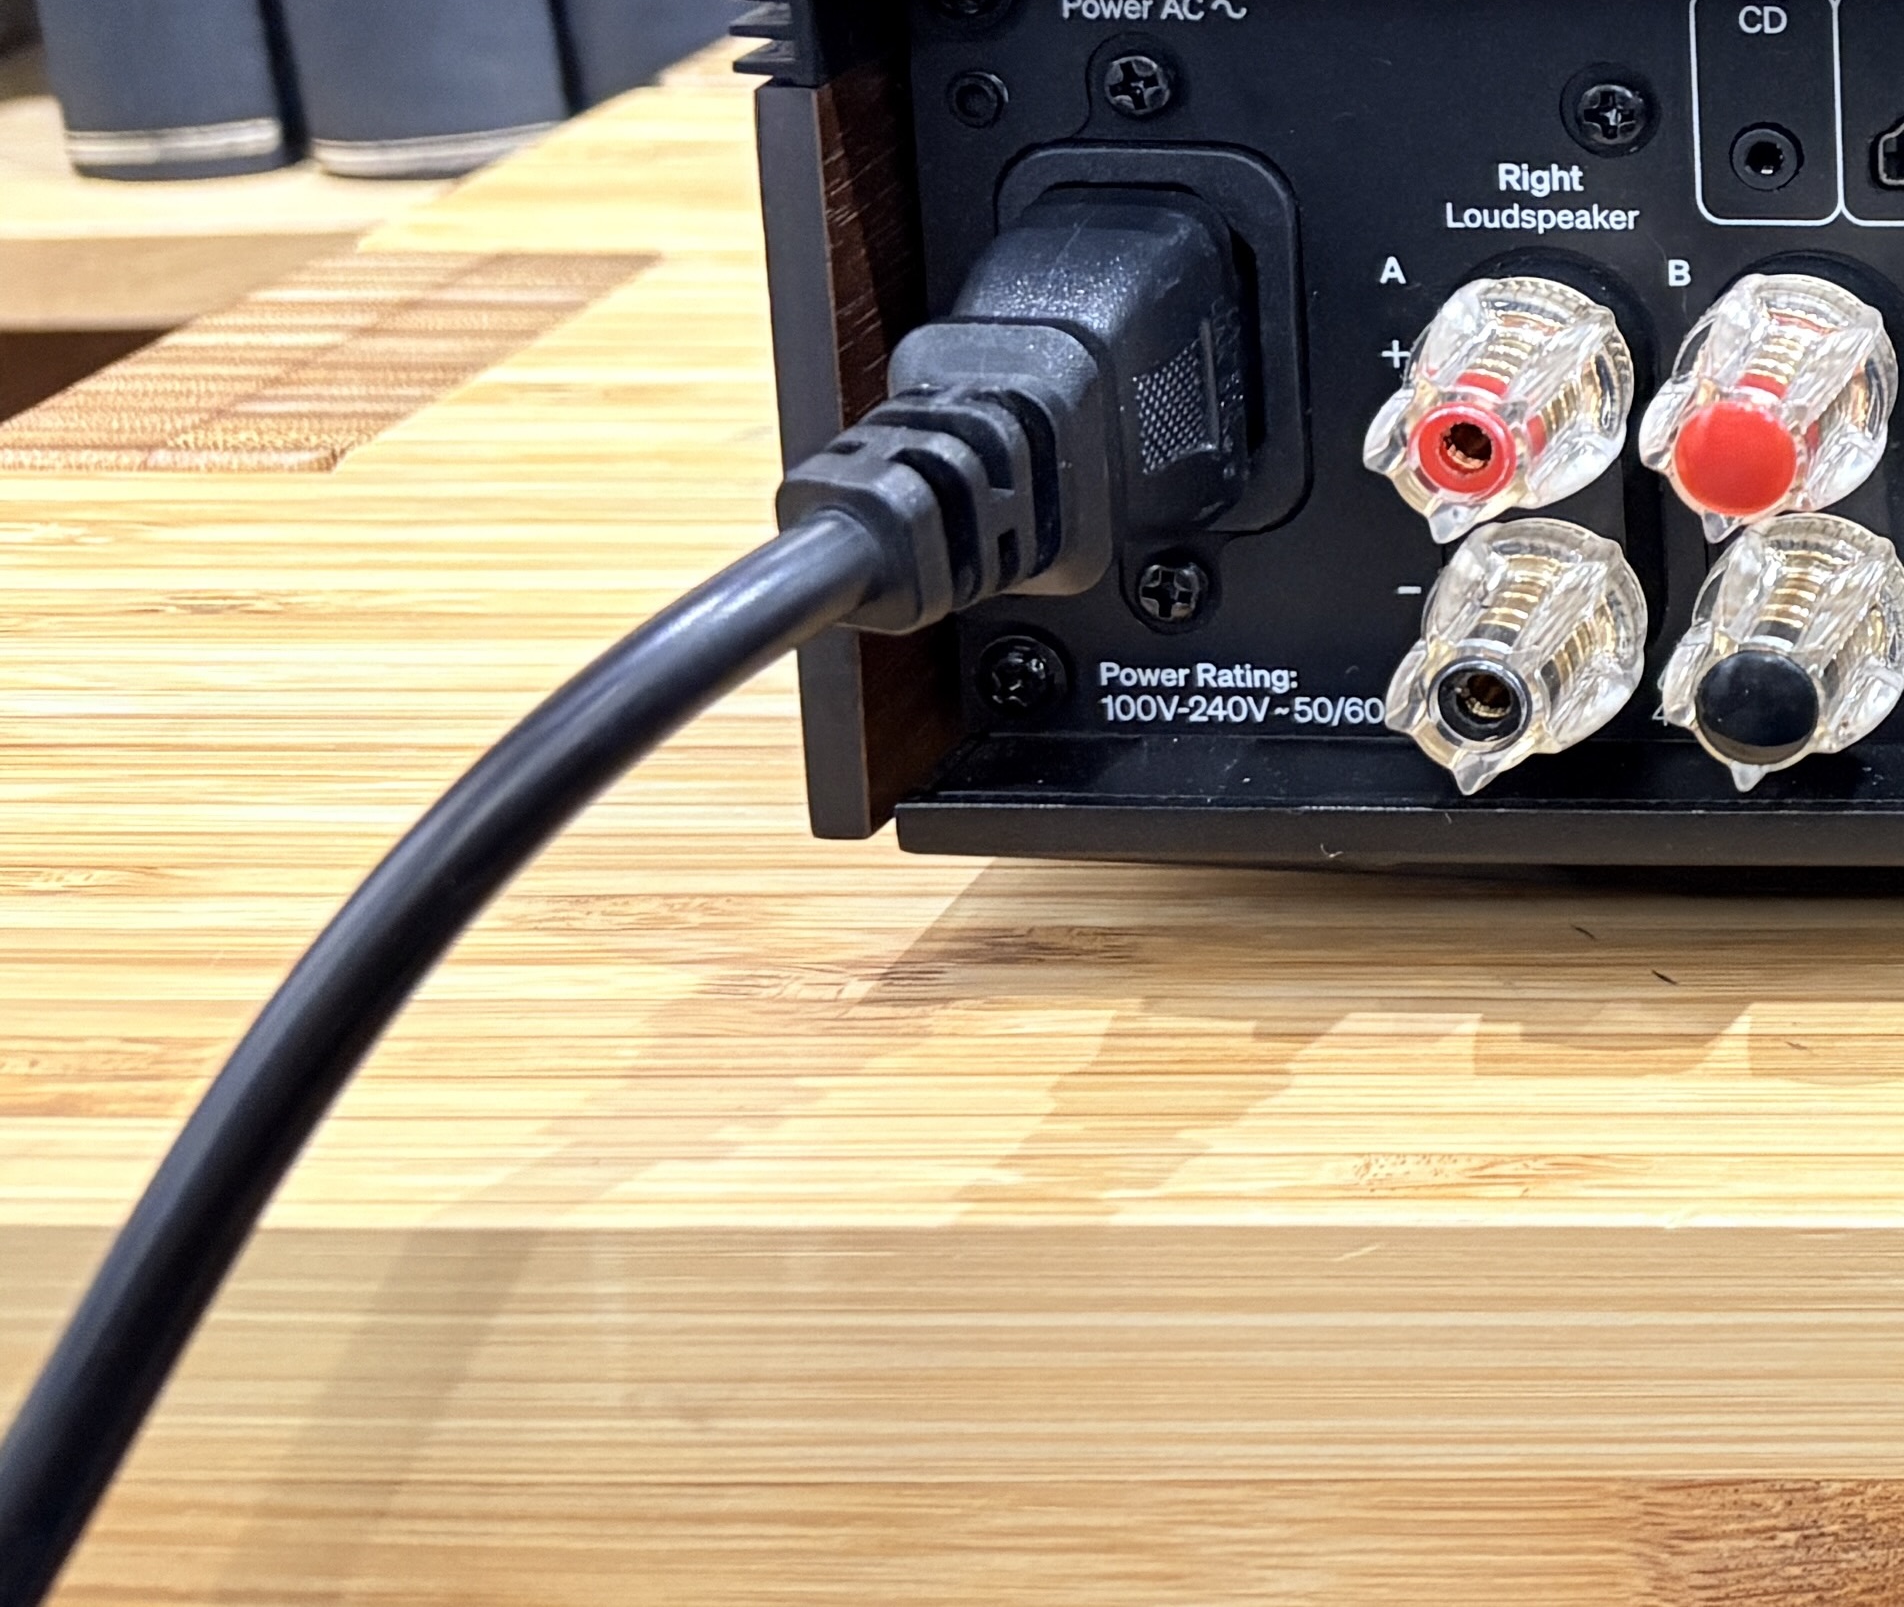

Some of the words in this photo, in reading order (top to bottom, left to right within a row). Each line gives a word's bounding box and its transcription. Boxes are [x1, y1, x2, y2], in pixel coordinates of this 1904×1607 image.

[1738, 5, 1788, 34] CD
[1497, 162, 1585, 198] Right
[1445, 201, 1640, 235] Loudspeaker
[1379, 256, 1407, 285] A
[1667, 259, 1692, 287] B
[1099, 661, 1191, 688] Power
[1195, 662, 1298, 694] Rating:
